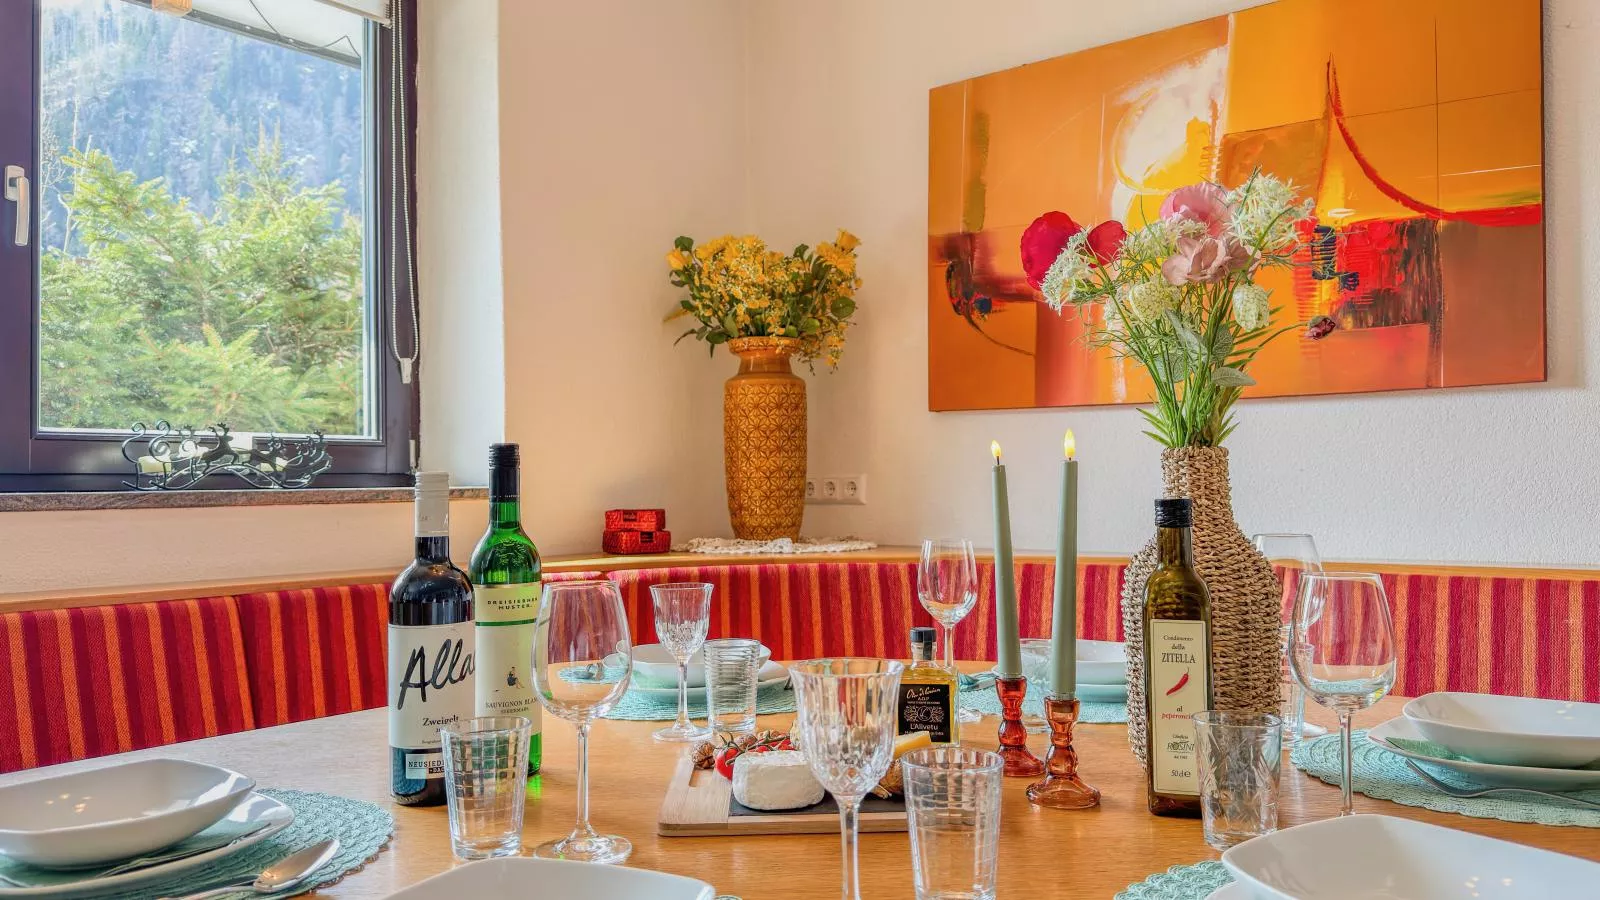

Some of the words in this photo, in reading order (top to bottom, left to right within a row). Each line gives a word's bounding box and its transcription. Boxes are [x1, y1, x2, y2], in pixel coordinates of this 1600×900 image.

[1161, 652, 1196, 664] ZITELLA
[485, 699, 523, 709] SAUVIGNON
[422, 714, 459, 726] Zweigelt
